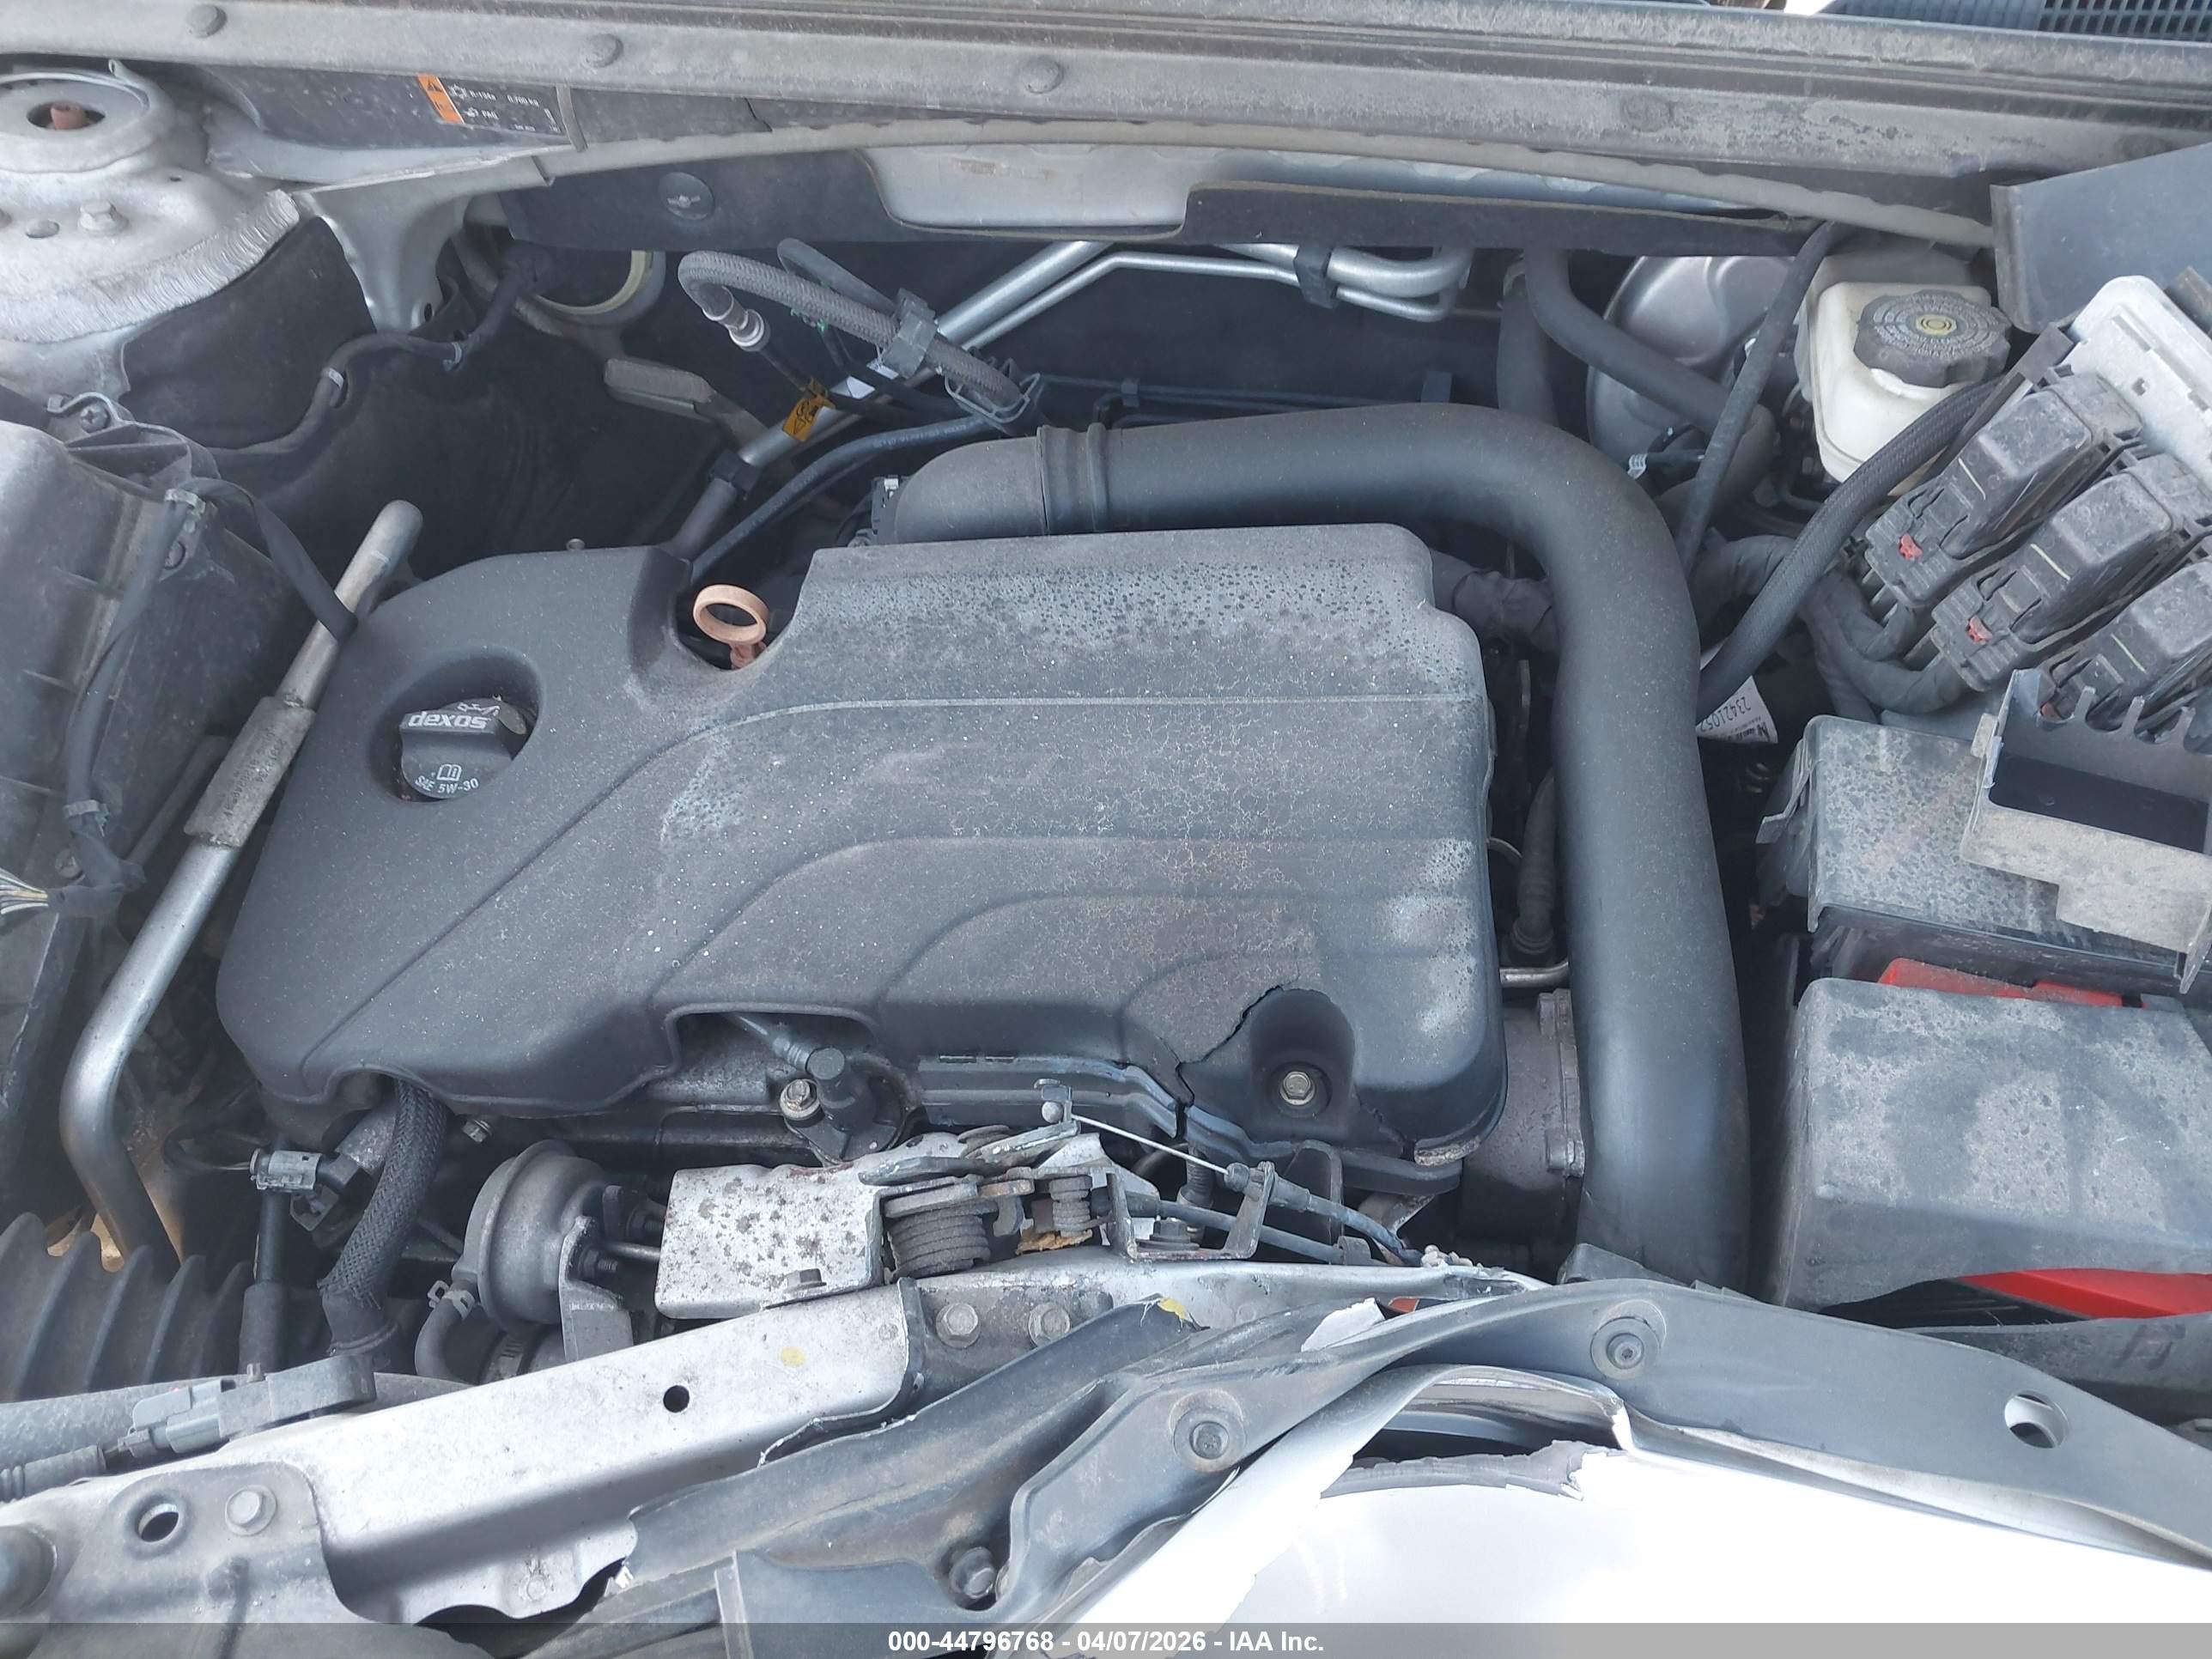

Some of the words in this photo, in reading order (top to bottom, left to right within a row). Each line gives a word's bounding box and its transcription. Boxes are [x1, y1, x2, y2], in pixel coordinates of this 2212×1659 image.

[408, 712, 490, 729] dexos
[415, 775, 434, 792] SAE
[438, 777, 479, 793] 5W-30
